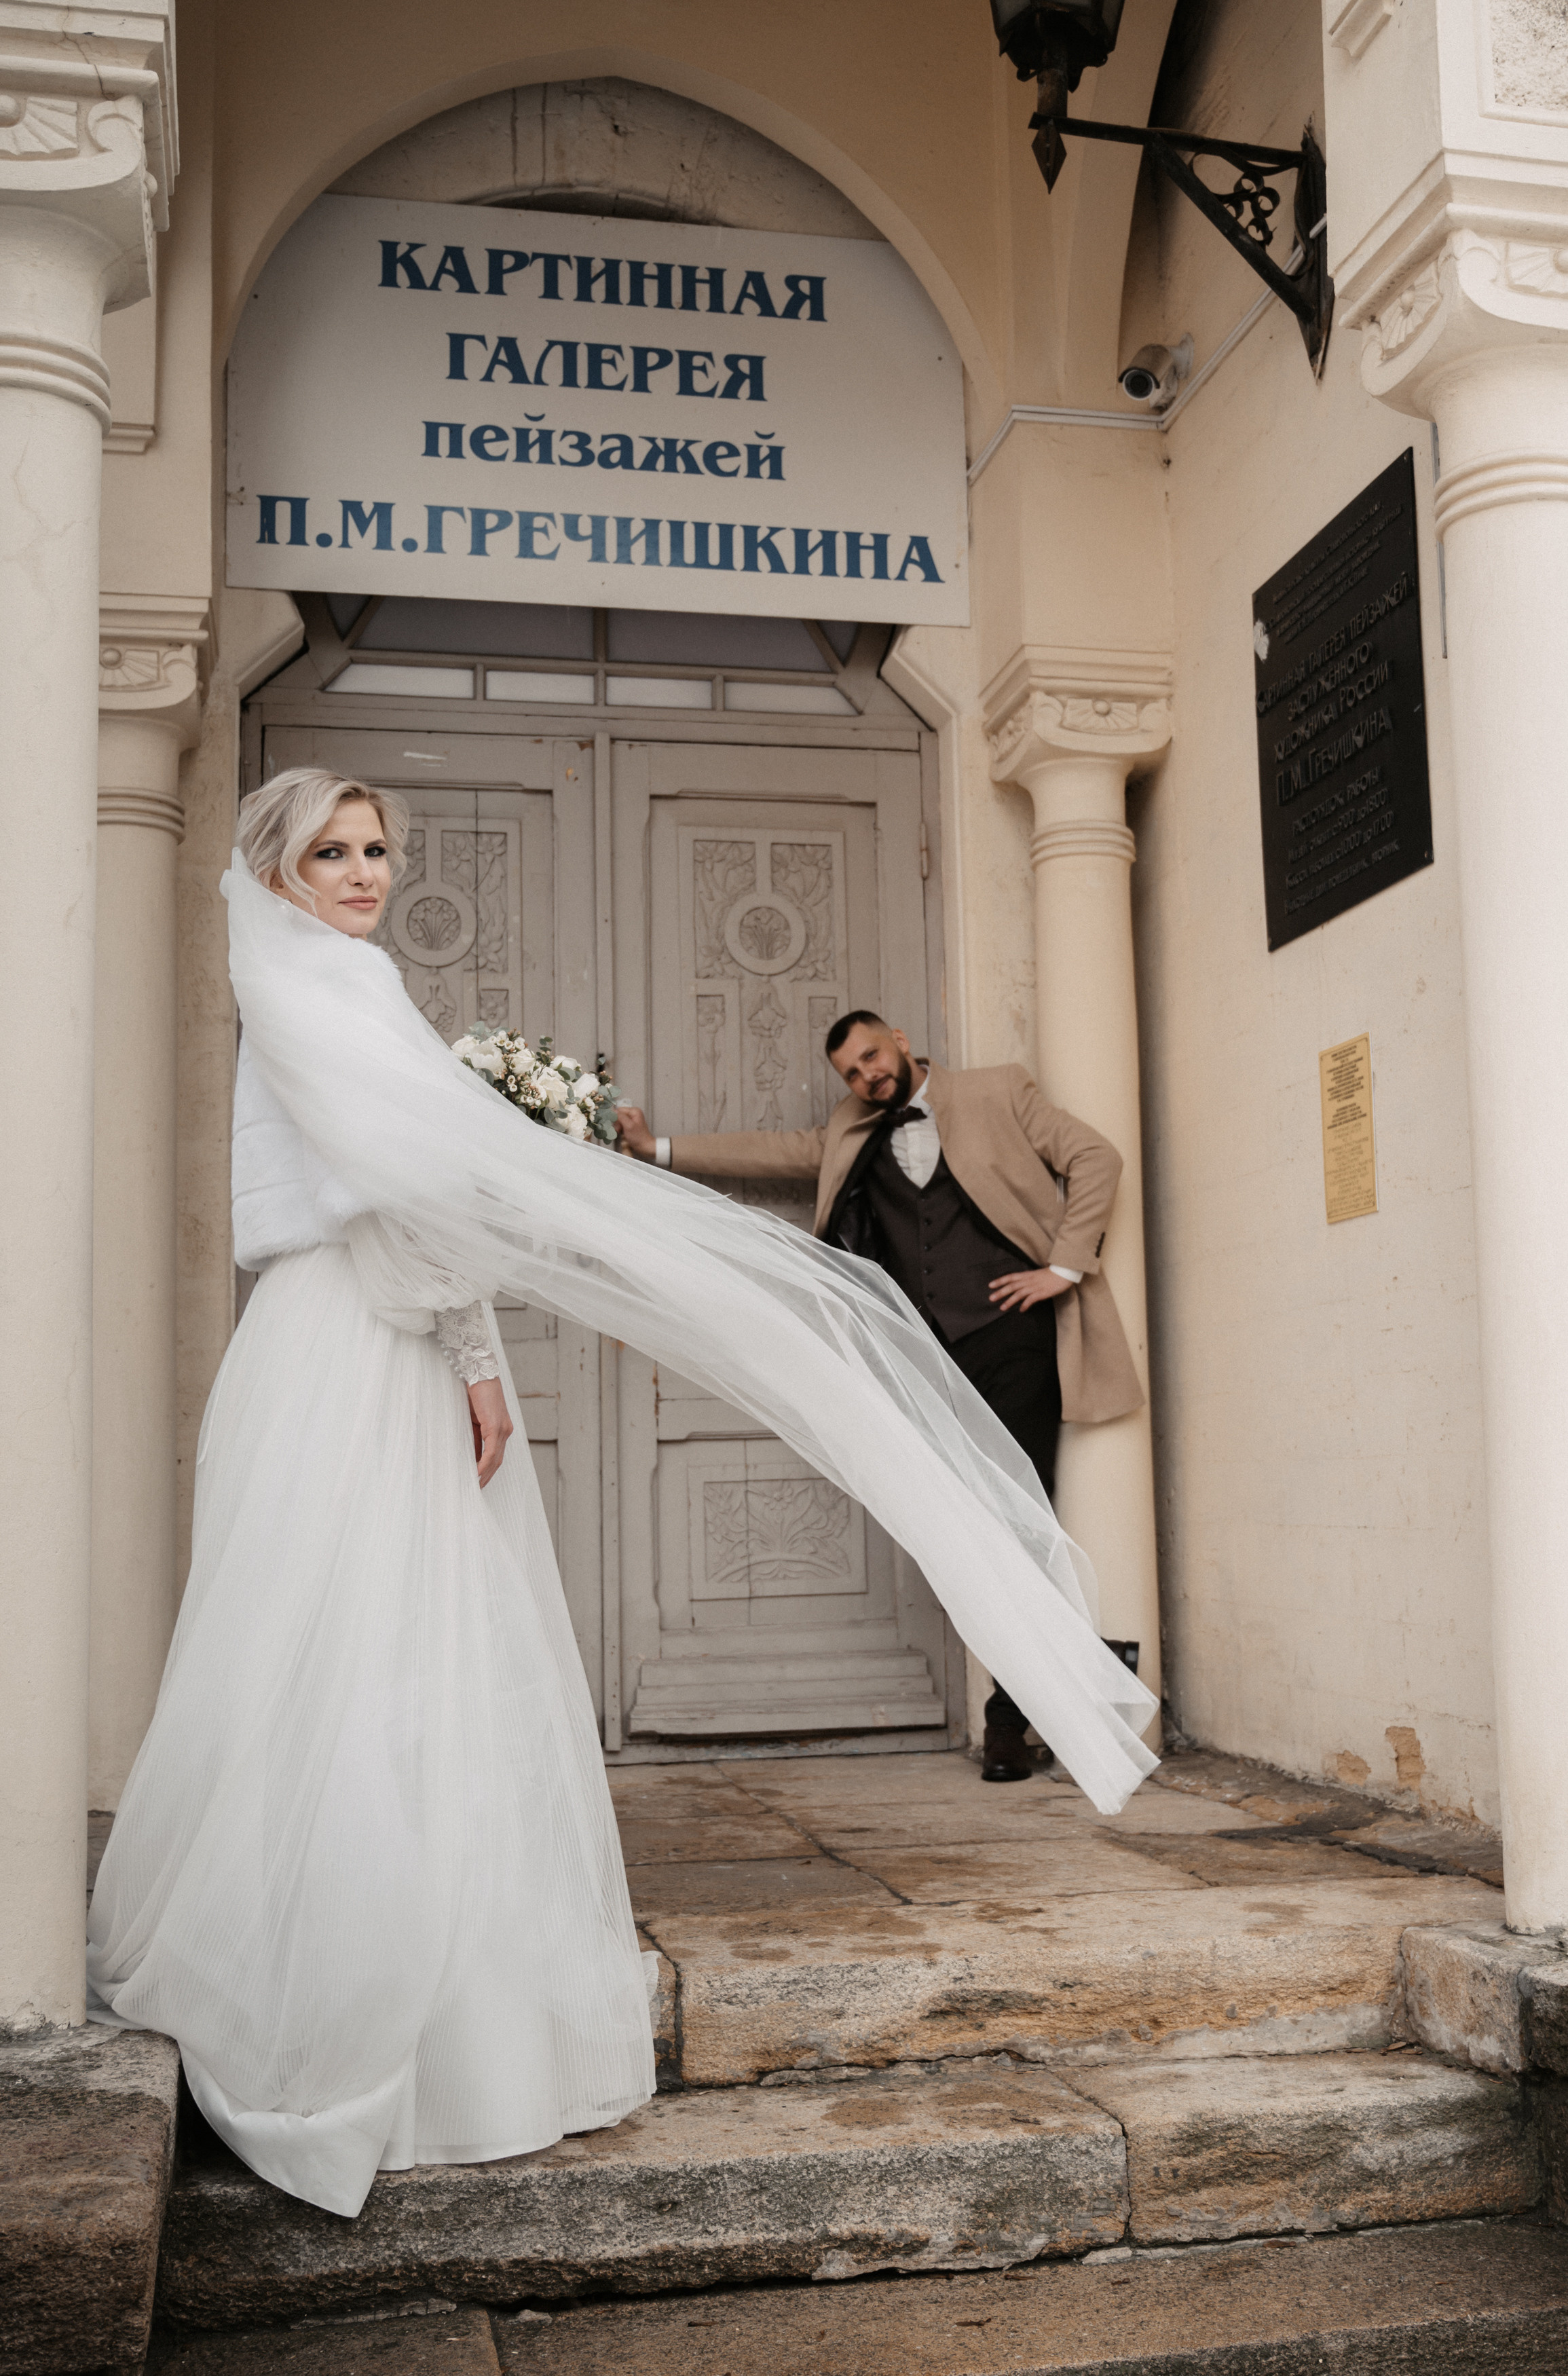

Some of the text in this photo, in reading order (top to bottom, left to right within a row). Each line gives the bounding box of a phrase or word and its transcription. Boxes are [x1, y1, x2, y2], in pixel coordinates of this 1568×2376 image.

[378, 239, 827, 322] КАРТИННАЯ
[446, 332, 766, 402] ГАЛЕРЕЯ
[422, 413, 785, 481] пейзажей
[256, 495, 946, 584] П.М.ГРЕЧИШКИНА
[1308, 628, 1345, 672] ГАЛЕРЕЯ
[1349, 572, 1407, 637] ПЕЙЗАЖЕЙ
[1287, 644, 1369, 720] ЗАСЛУЖЕННОГО
